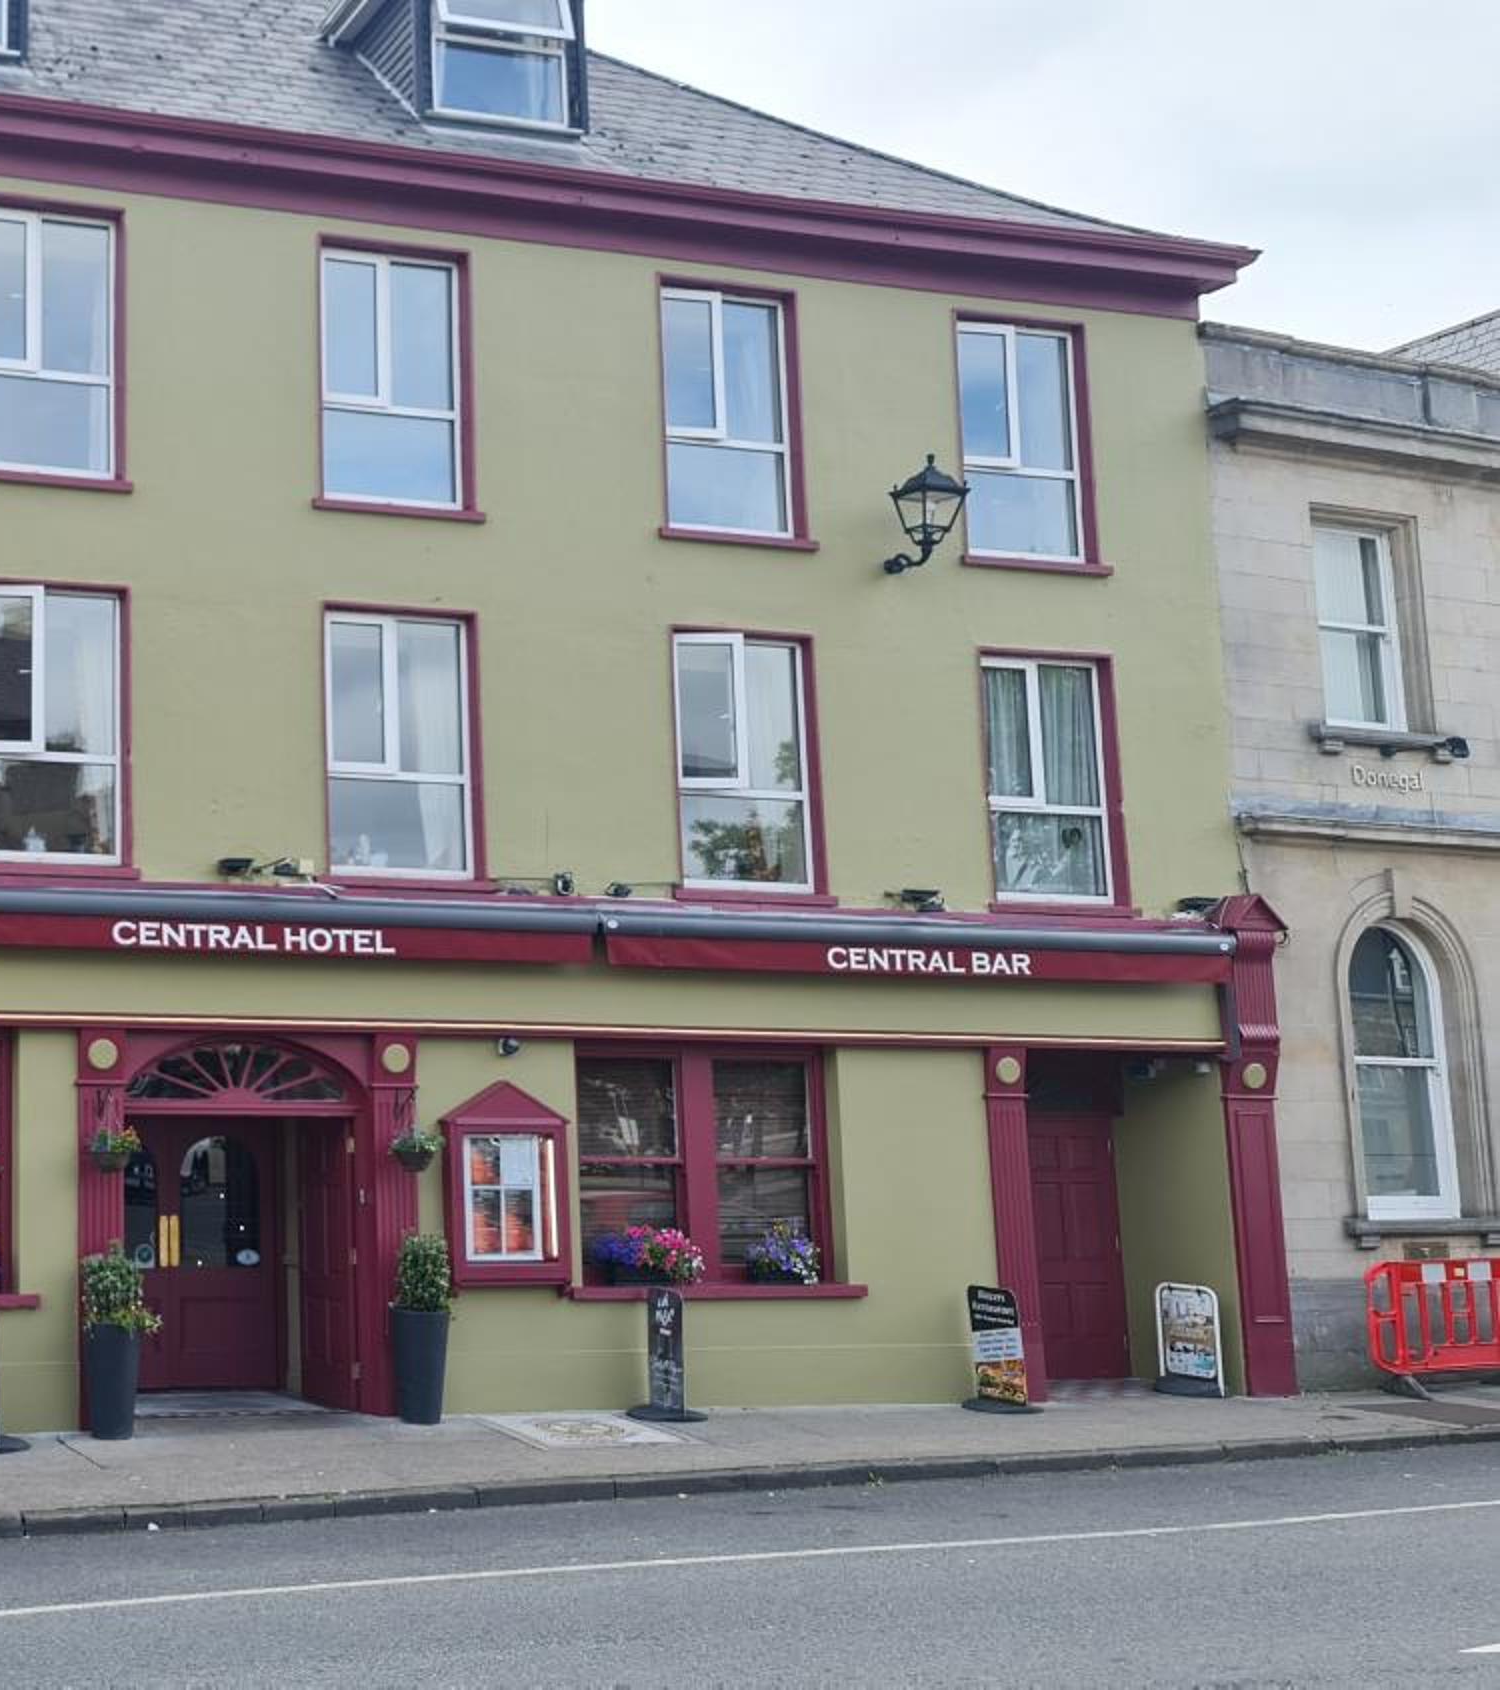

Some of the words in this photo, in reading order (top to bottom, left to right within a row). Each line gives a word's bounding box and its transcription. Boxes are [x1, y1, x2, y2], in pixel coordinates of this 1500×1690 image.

[1352, 765, 1425, 793] Donegal
[111, 920, 277, 950] CENTRAL
[284, 927, 396, 954] HOTEL
[827, 947, 966, 973] CENTRAL
[971, 951, 1032, 975] BAR
